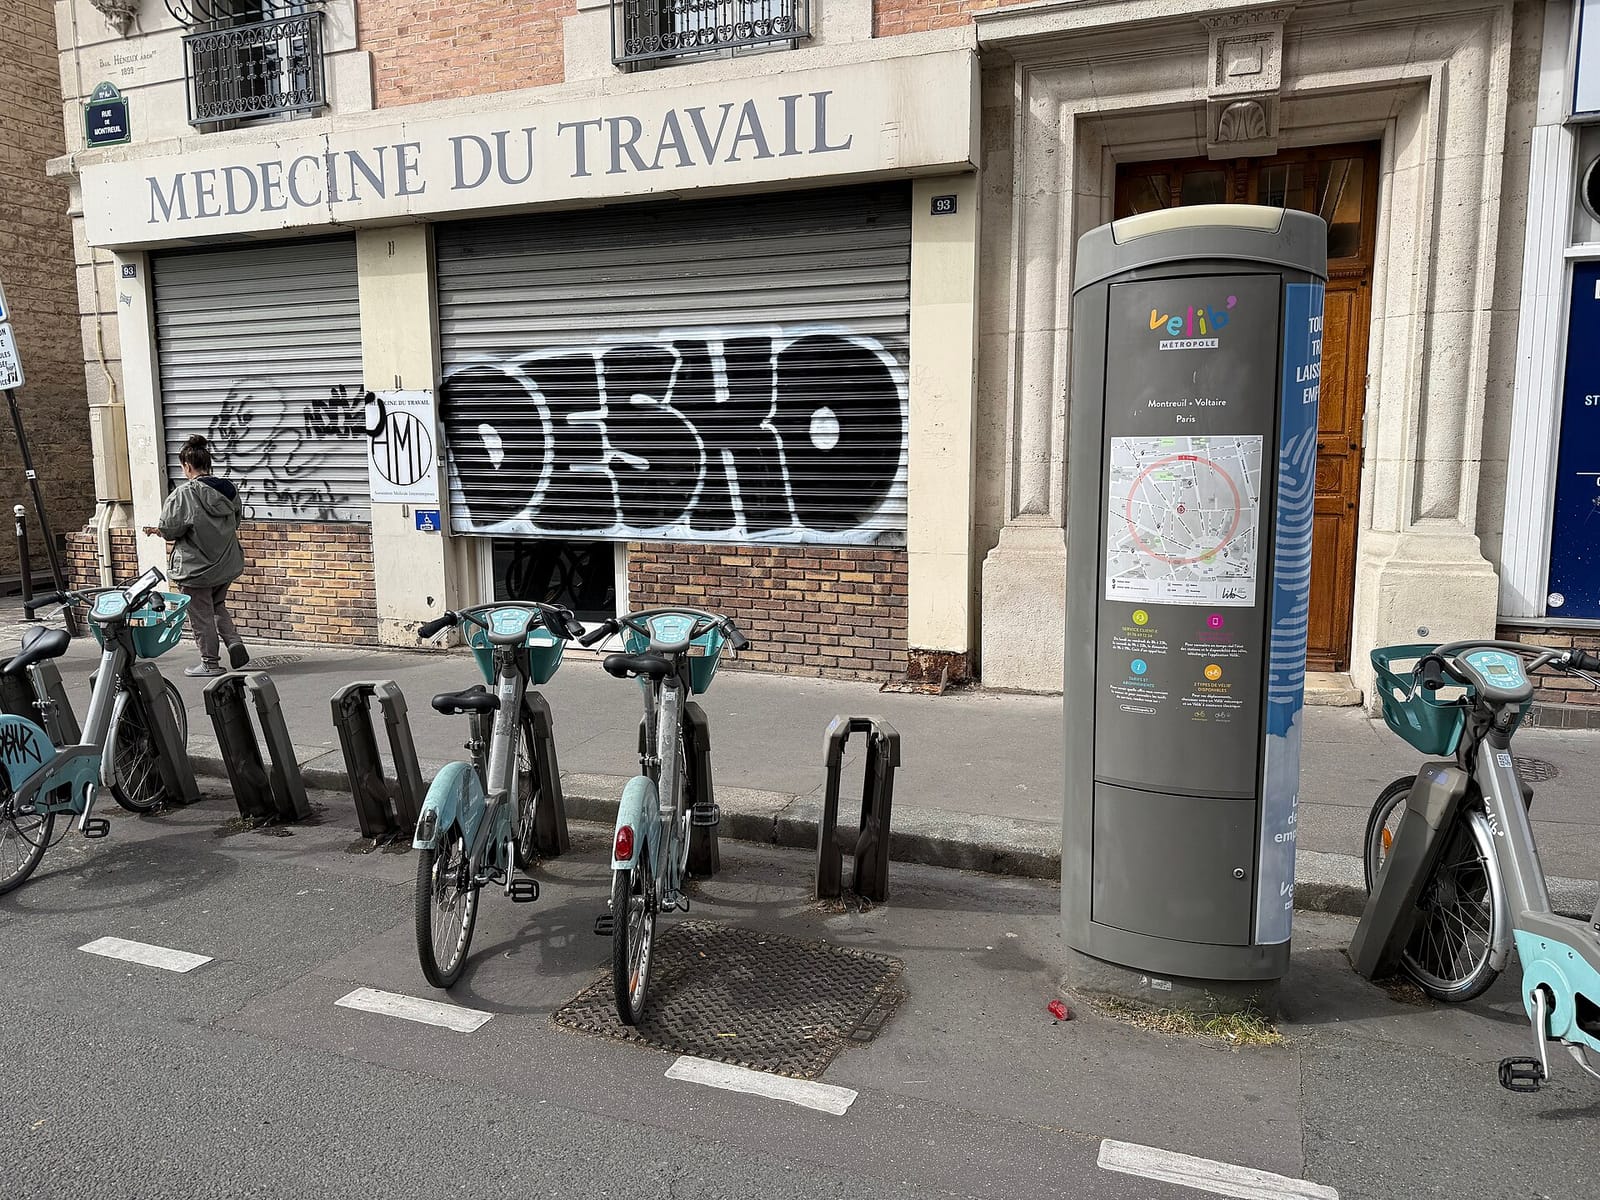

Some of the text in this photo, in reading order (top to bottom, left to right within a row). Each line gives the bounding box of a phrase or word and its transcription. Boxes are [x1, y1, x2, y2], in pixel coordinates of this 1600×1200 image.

[101, 110, 112, 118] RUE
[94, 126, 122, 136] MONTREUIL
[146, 90, 853, 224] MEDECINE DU TRAVAIL
[936, 199, 951, 211] 93
[123, 267, 134, 276] 93
[1148, 398, 1227, 408] Montreuil Voltaire
[1176, 414, 1196, 423] Paris
